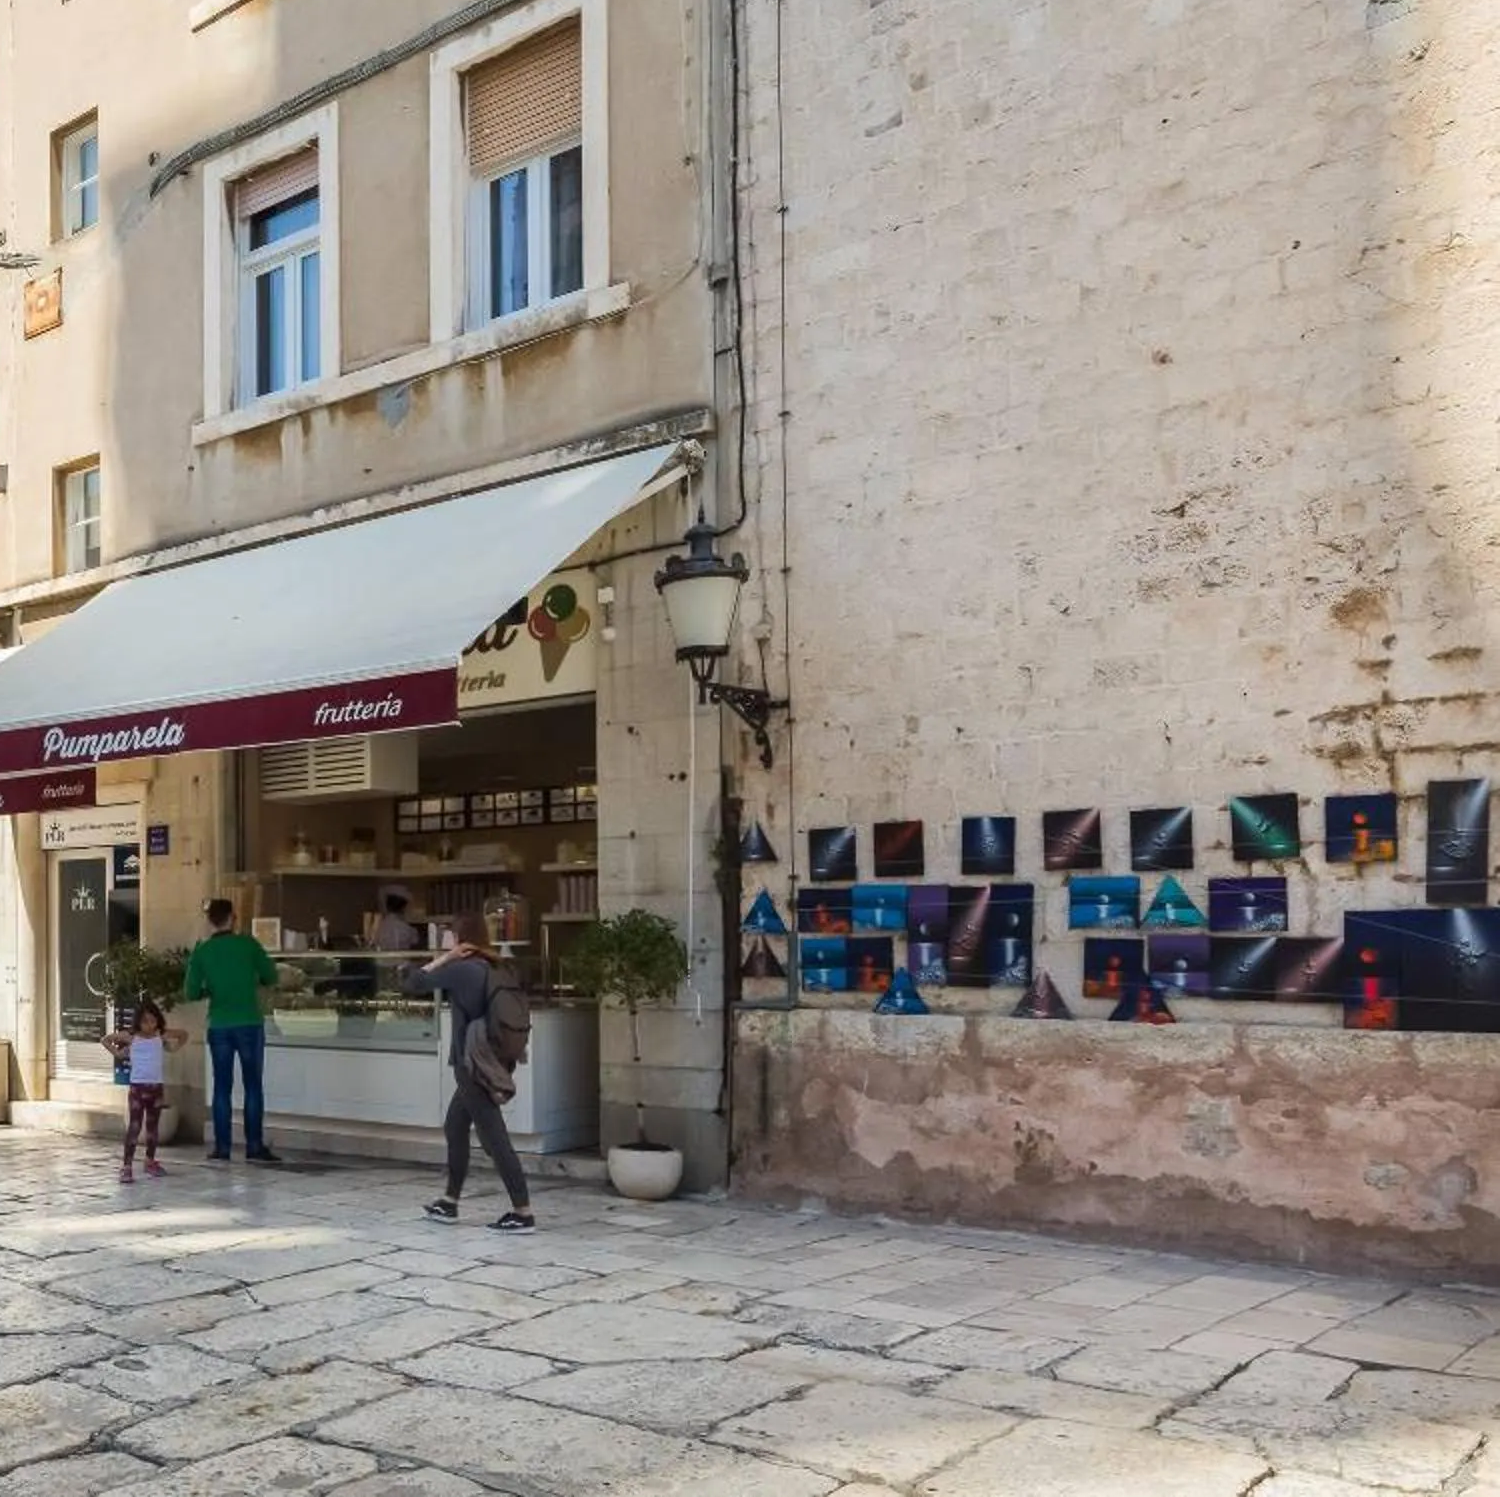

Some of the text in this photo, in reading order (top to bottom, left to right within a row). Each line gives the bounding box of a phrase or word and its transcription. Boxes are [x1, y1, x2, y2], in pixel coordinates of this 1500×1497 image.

[460, 670, 507, 694] teria
[314, 692, 403, 725] frutteria
[43, 717, 186, 762] Pumparela
